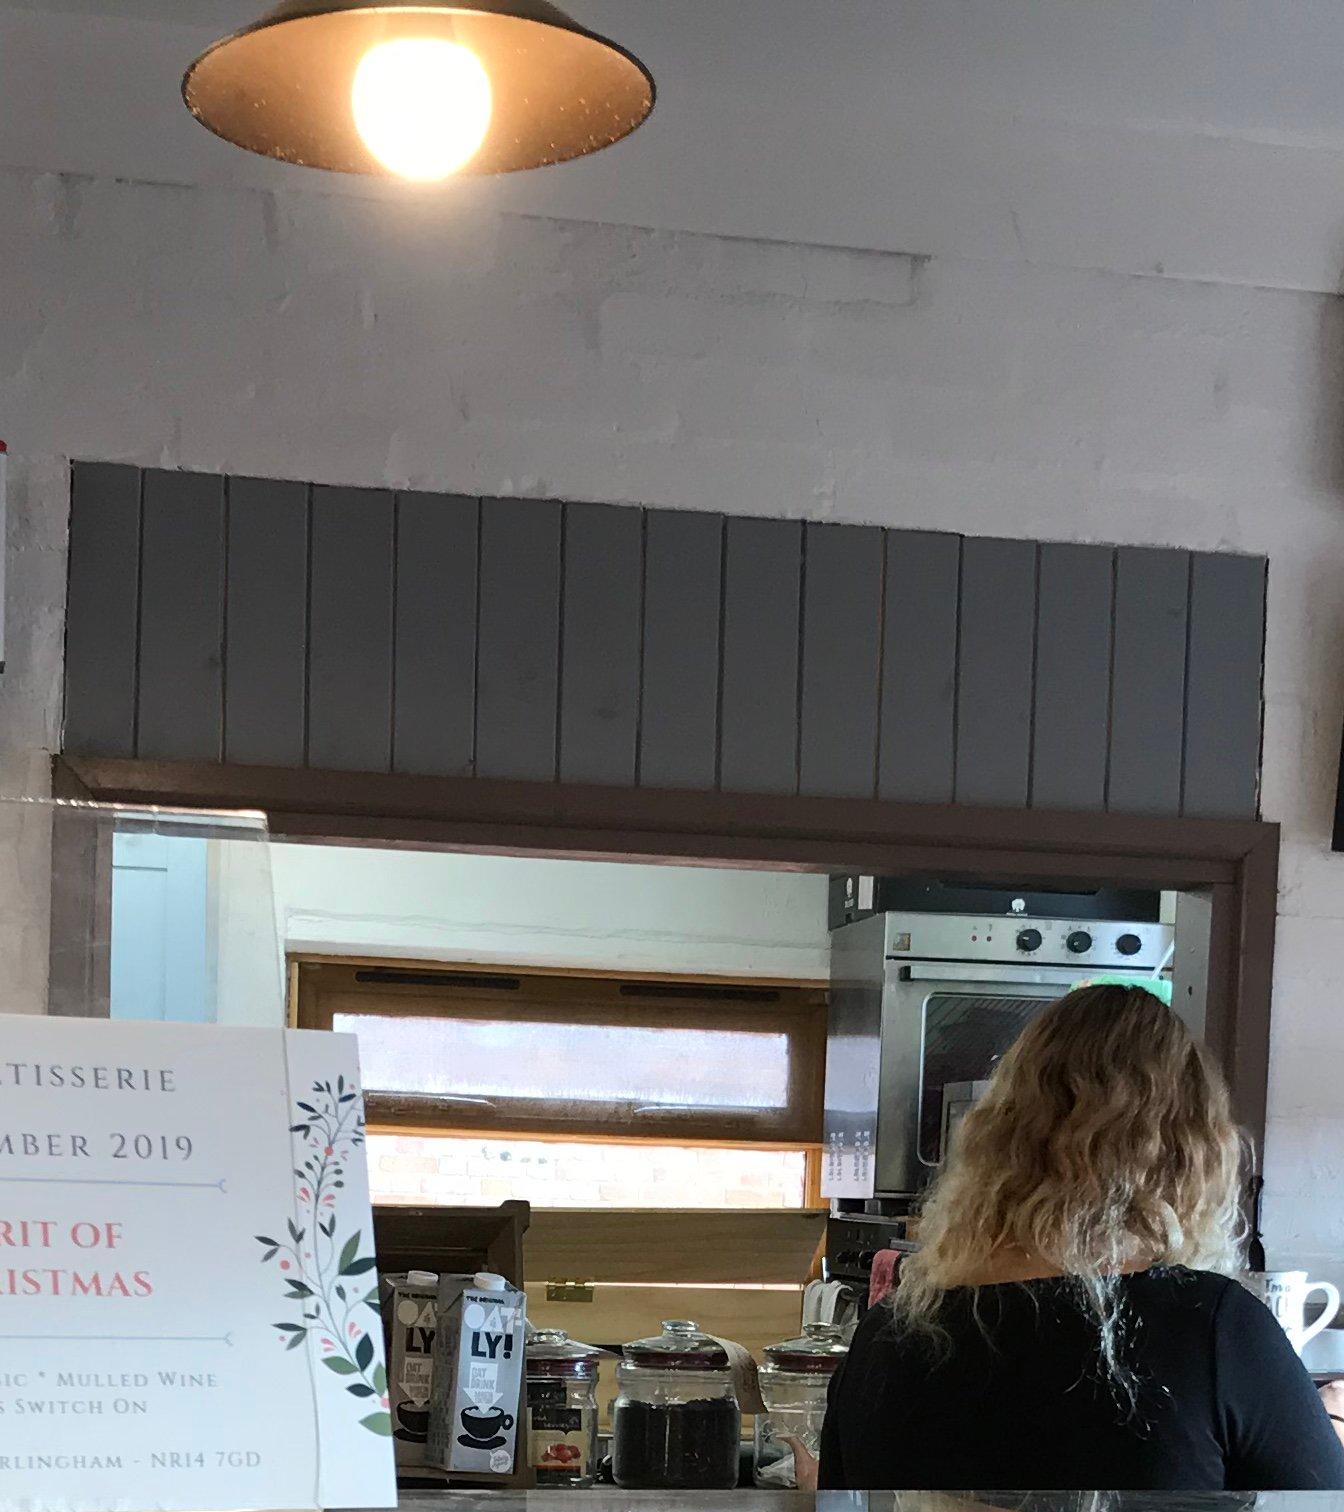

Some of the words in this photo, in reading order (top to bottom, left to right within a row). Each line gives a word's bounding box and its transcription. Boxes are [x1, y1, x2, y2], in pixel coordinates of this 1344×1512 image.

[110, 1132, 195, 1162] 2019
[69, 1221, 124, 1250] OF
[470, 1331, 514, 1360] LY!
[150, 1451, 206, 1470] NR14
[215, 1451, 263, 1470] 7GD
